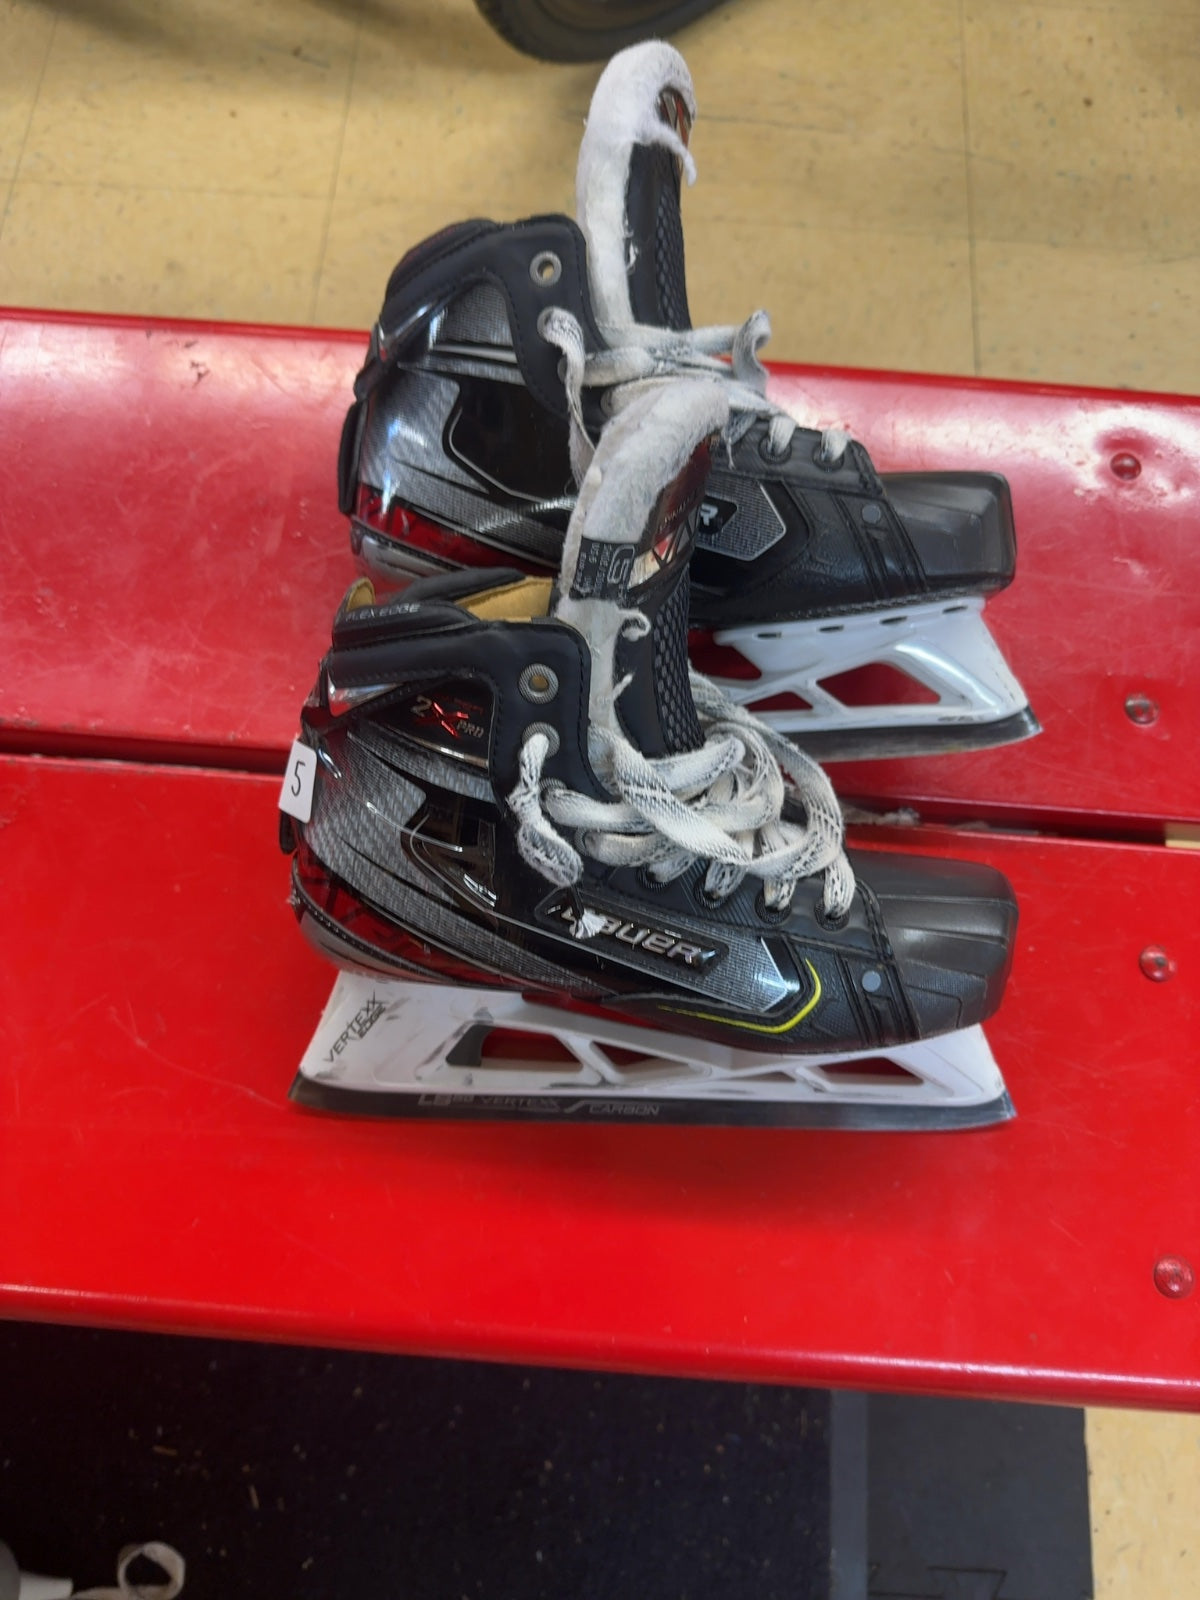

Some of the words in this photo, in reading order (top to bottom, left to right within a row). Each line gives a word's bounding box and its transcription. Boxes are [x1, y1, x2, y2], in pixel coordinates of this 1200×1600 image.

[456, 719, 485, 738] PRO
[291, 760, 306, 797] 5
[588, 1102, 660, 1116] CARBON
